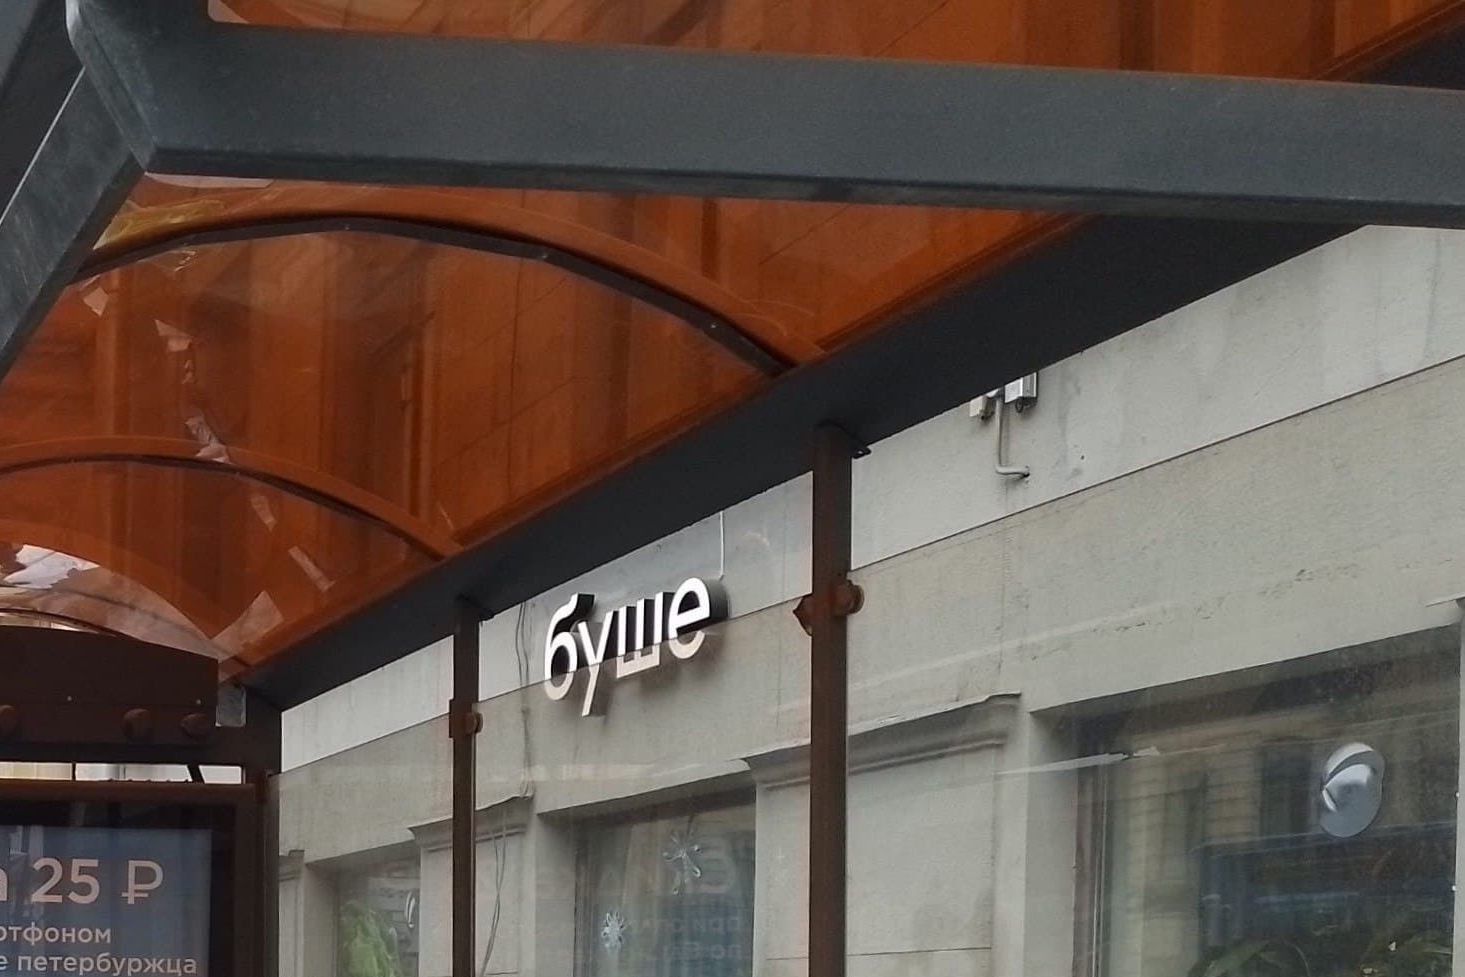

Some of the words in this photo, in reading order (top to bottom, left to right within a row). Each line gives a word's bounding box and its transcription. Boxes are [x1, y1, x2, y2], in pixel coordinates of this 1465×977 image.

[544, 577, 711, 717] буше
[31, 857, 100, 904] 25
[18, 952, 196, 977] петербуржца
